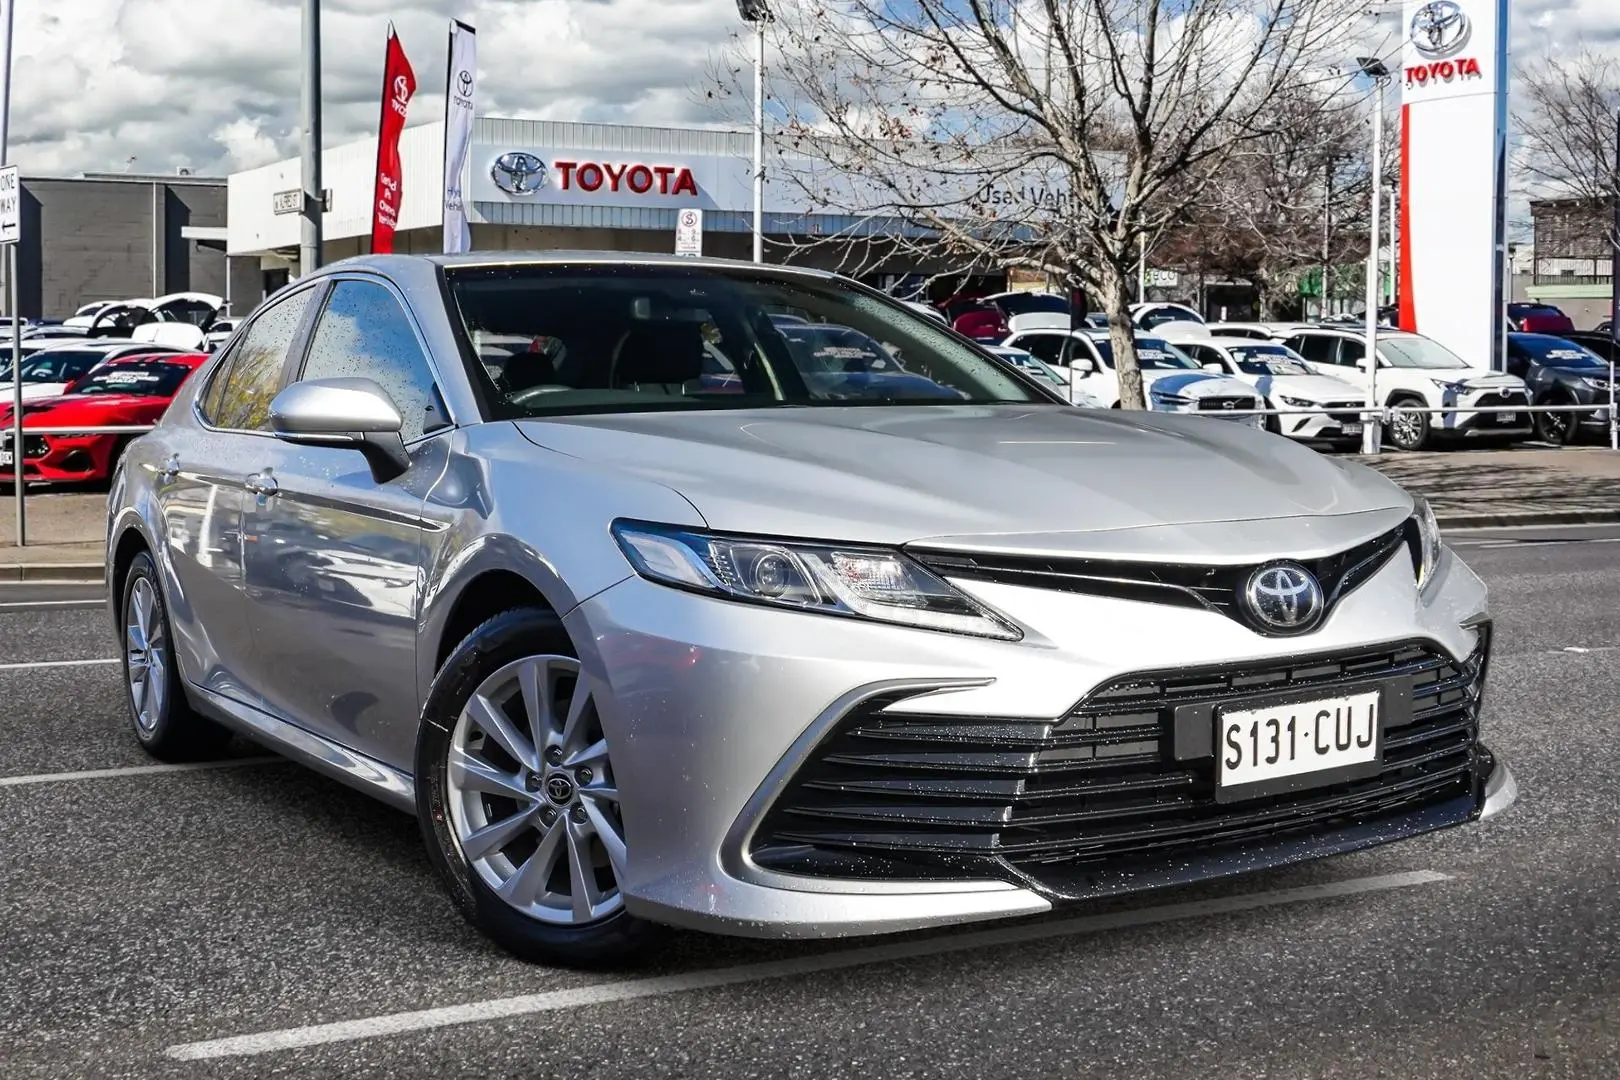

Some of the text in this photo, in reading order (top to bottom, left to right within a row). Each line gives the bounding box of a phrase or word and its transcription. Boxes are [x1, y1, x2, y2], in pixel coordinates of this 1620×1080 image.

[1404, 58, 1481, 83] TOYOTA
[1, 173, 16, 191] ONE
[555, 161, 698, 196] TOYOTA
[0, 196, 17, 214] WAY
